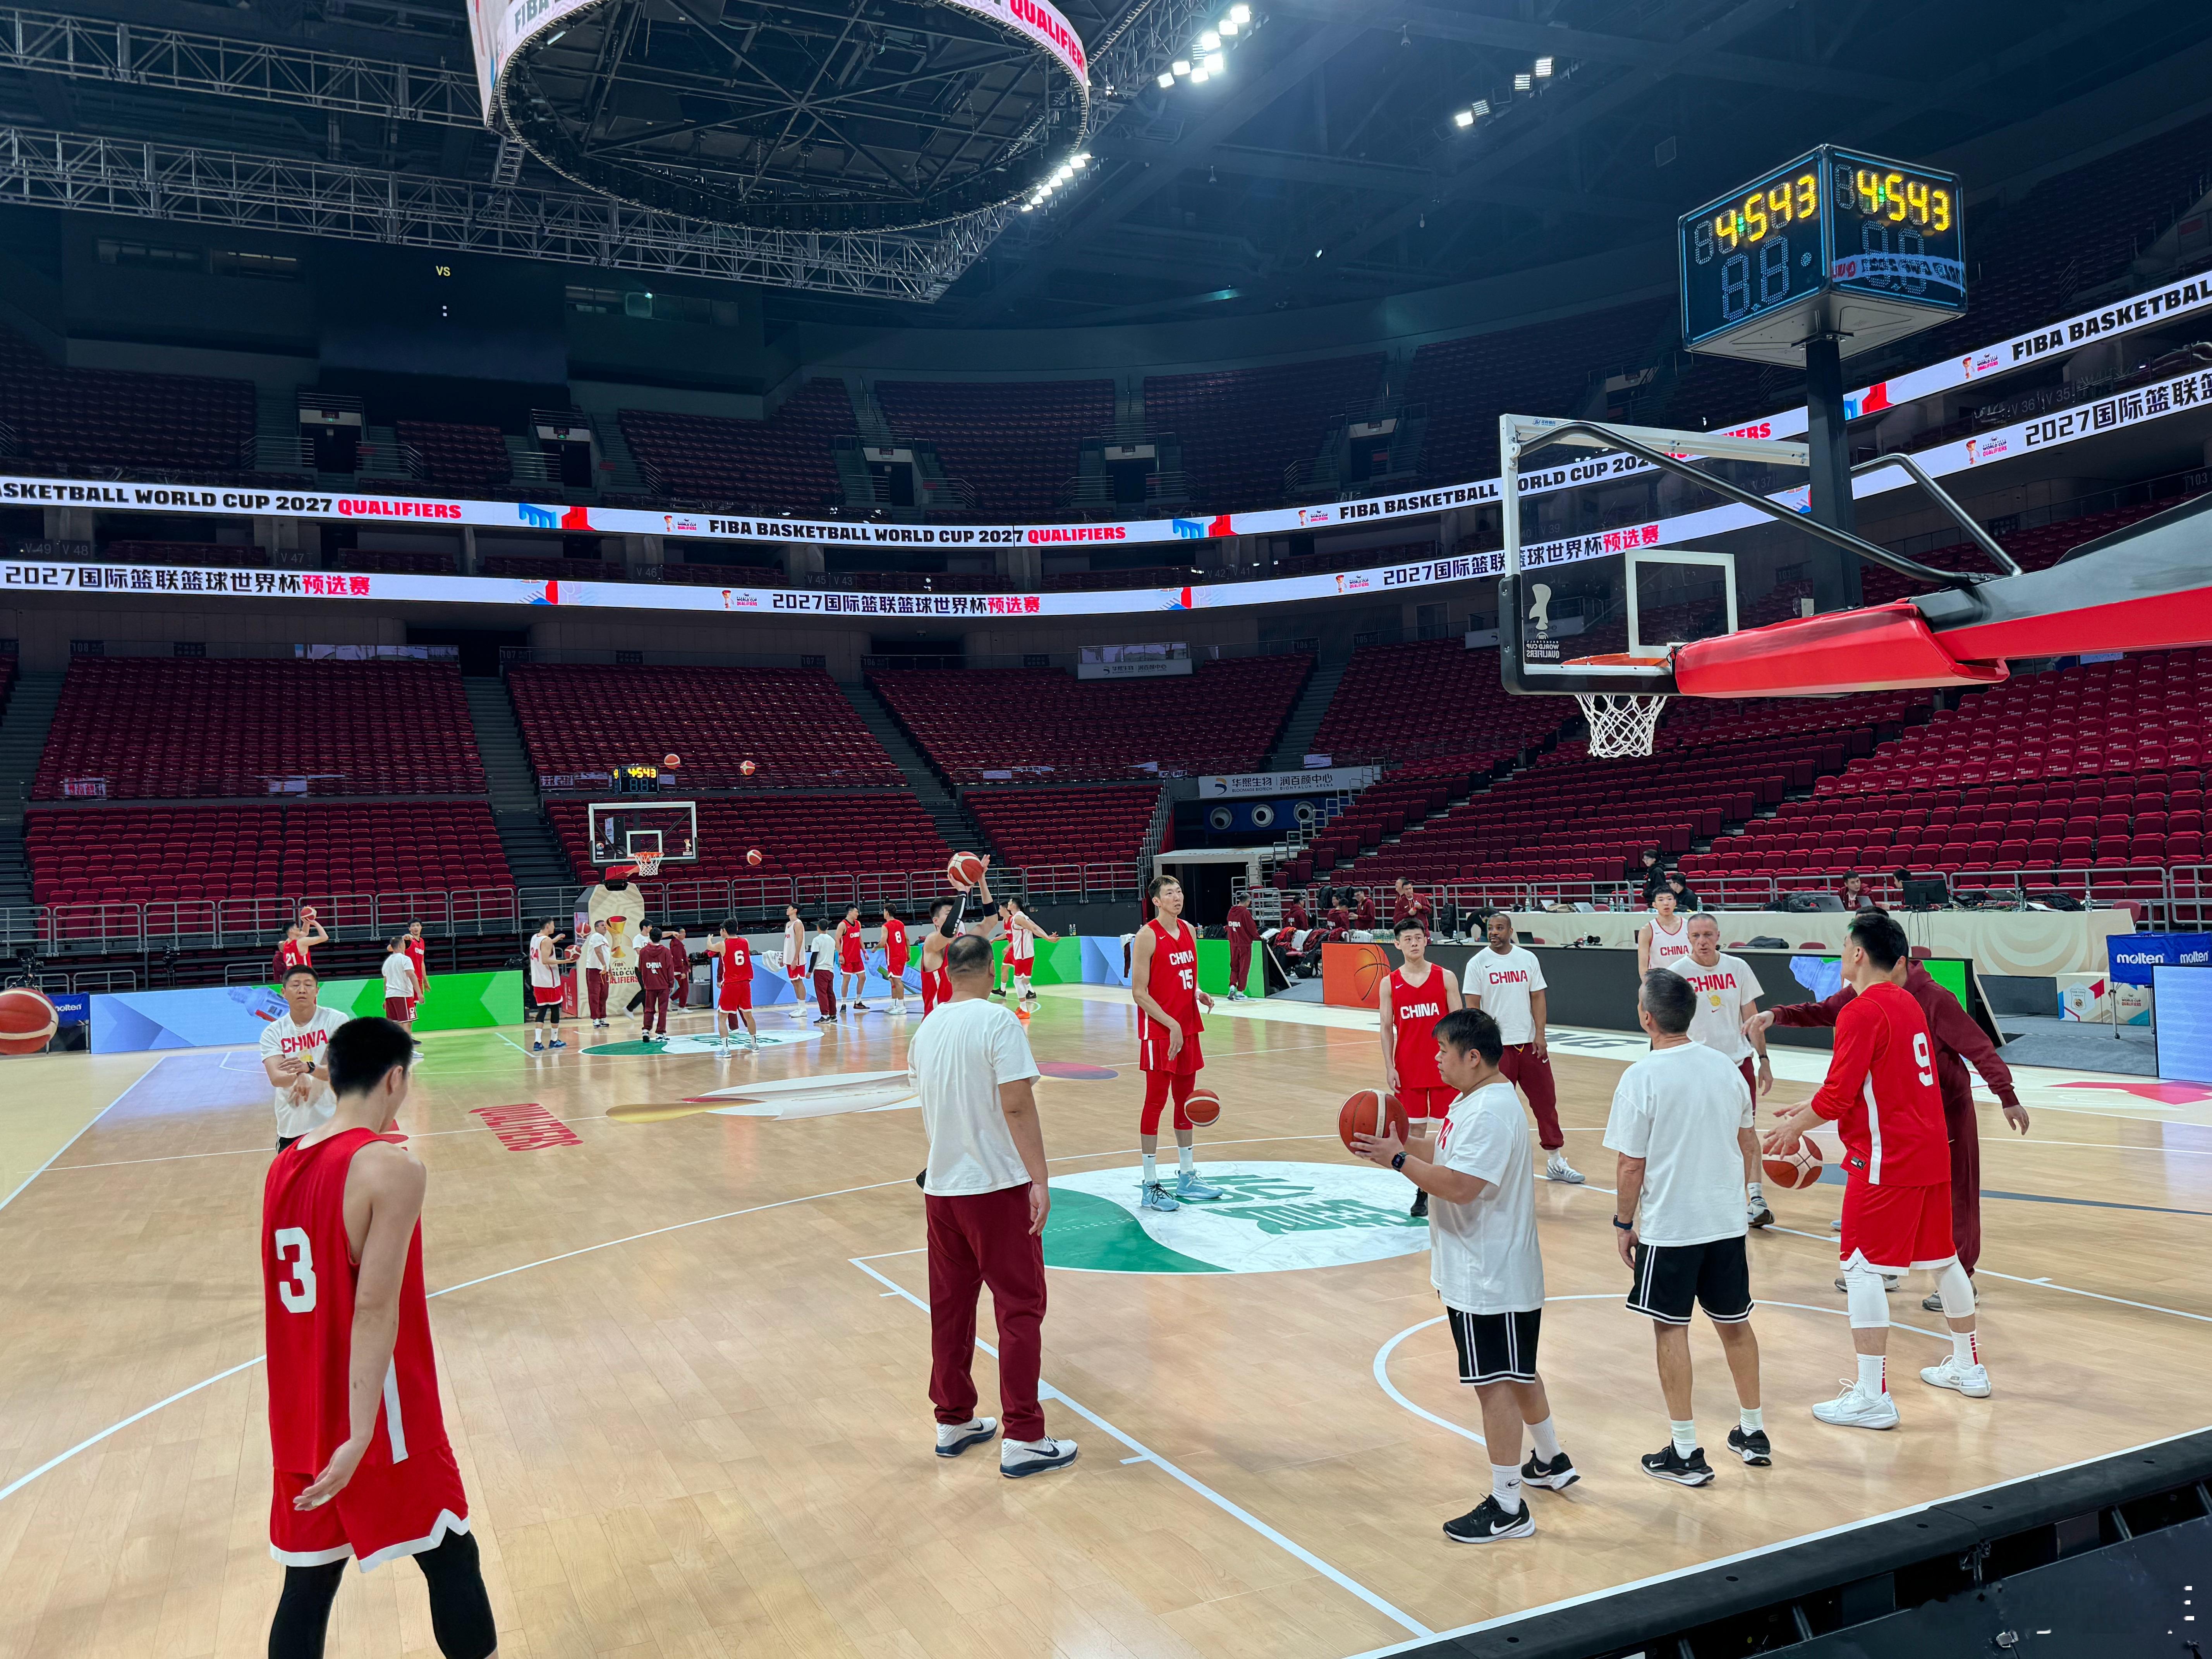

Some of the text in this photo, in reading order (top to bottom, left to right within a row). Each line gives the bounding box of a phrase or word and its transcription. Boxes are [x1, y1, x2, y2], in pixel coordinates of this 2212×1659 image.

[1010, 0, 1085, 74] QUALIFIER
[436, 266, 450, 276] VS
[2012, 280, 2212, 361] FIBA BASKETBAL
[2056, 389, 2070, 402] 35
[2021, 399, 2035, 412] 36
[2190, 473, 2207, 487] 103
[1340, 456, 1651, 519] FIBA BASKETBALL ORLD CUP 202
[0, 482, 462, 519] SKETBALL WORLD CUP 2027 QUALIFIERS
[709, 519, 1126, 543] FIBA BASKETBALL WORLD CUP 2027 QUALIFIERS
[62, 544, 88, 555] V 48
[1384, 524, 1659, 586] 2027国际篮联球世界杯预选赛
[281, 553, 304, 563] V 47
[636, 567, 657, 577] V 46
[1215, 569, 1226, 578] 42
[1241, 567, 1250, 576] 41
[5, 566, 370, 596] 2027国际篮联篮球世界杯预选赛
[808, 575, 826, 584] V 45
[834, 576, 852, 586] V 43
[773, 594, 1041, 615] 2027国际篮联篮球世界杯预选赛
[72, 643, 88, 652] 108
[502, 651, 516, 659] 107
[802, 656, 814, 666] 107
[1232, 773, 1333, 787] 华熙生物 润百颜中心
[895, 931, 902, 943] 8
[1169, 950, 1194, 965] CHINA
[1660, 945, 1689, 956] CHINA
[2180, 951, 2208, 963] molten
[285, 952, 297, 967] 21
[734, 950, 745, 966] 6
[2117, 953, 2164, 965] molten
[1178, 969, 1193, 990] 15
[1489, 969, 1528, 985] CHINA
[1686, 973, 1736, 993] CHINA
[1400, 1002, 1439, 1020] CHINA
[281, 1029, 328, 1053] CHINA
[1913, 1032, 1934, 1086] 9
[275, 1227, 316, 1313] 3
